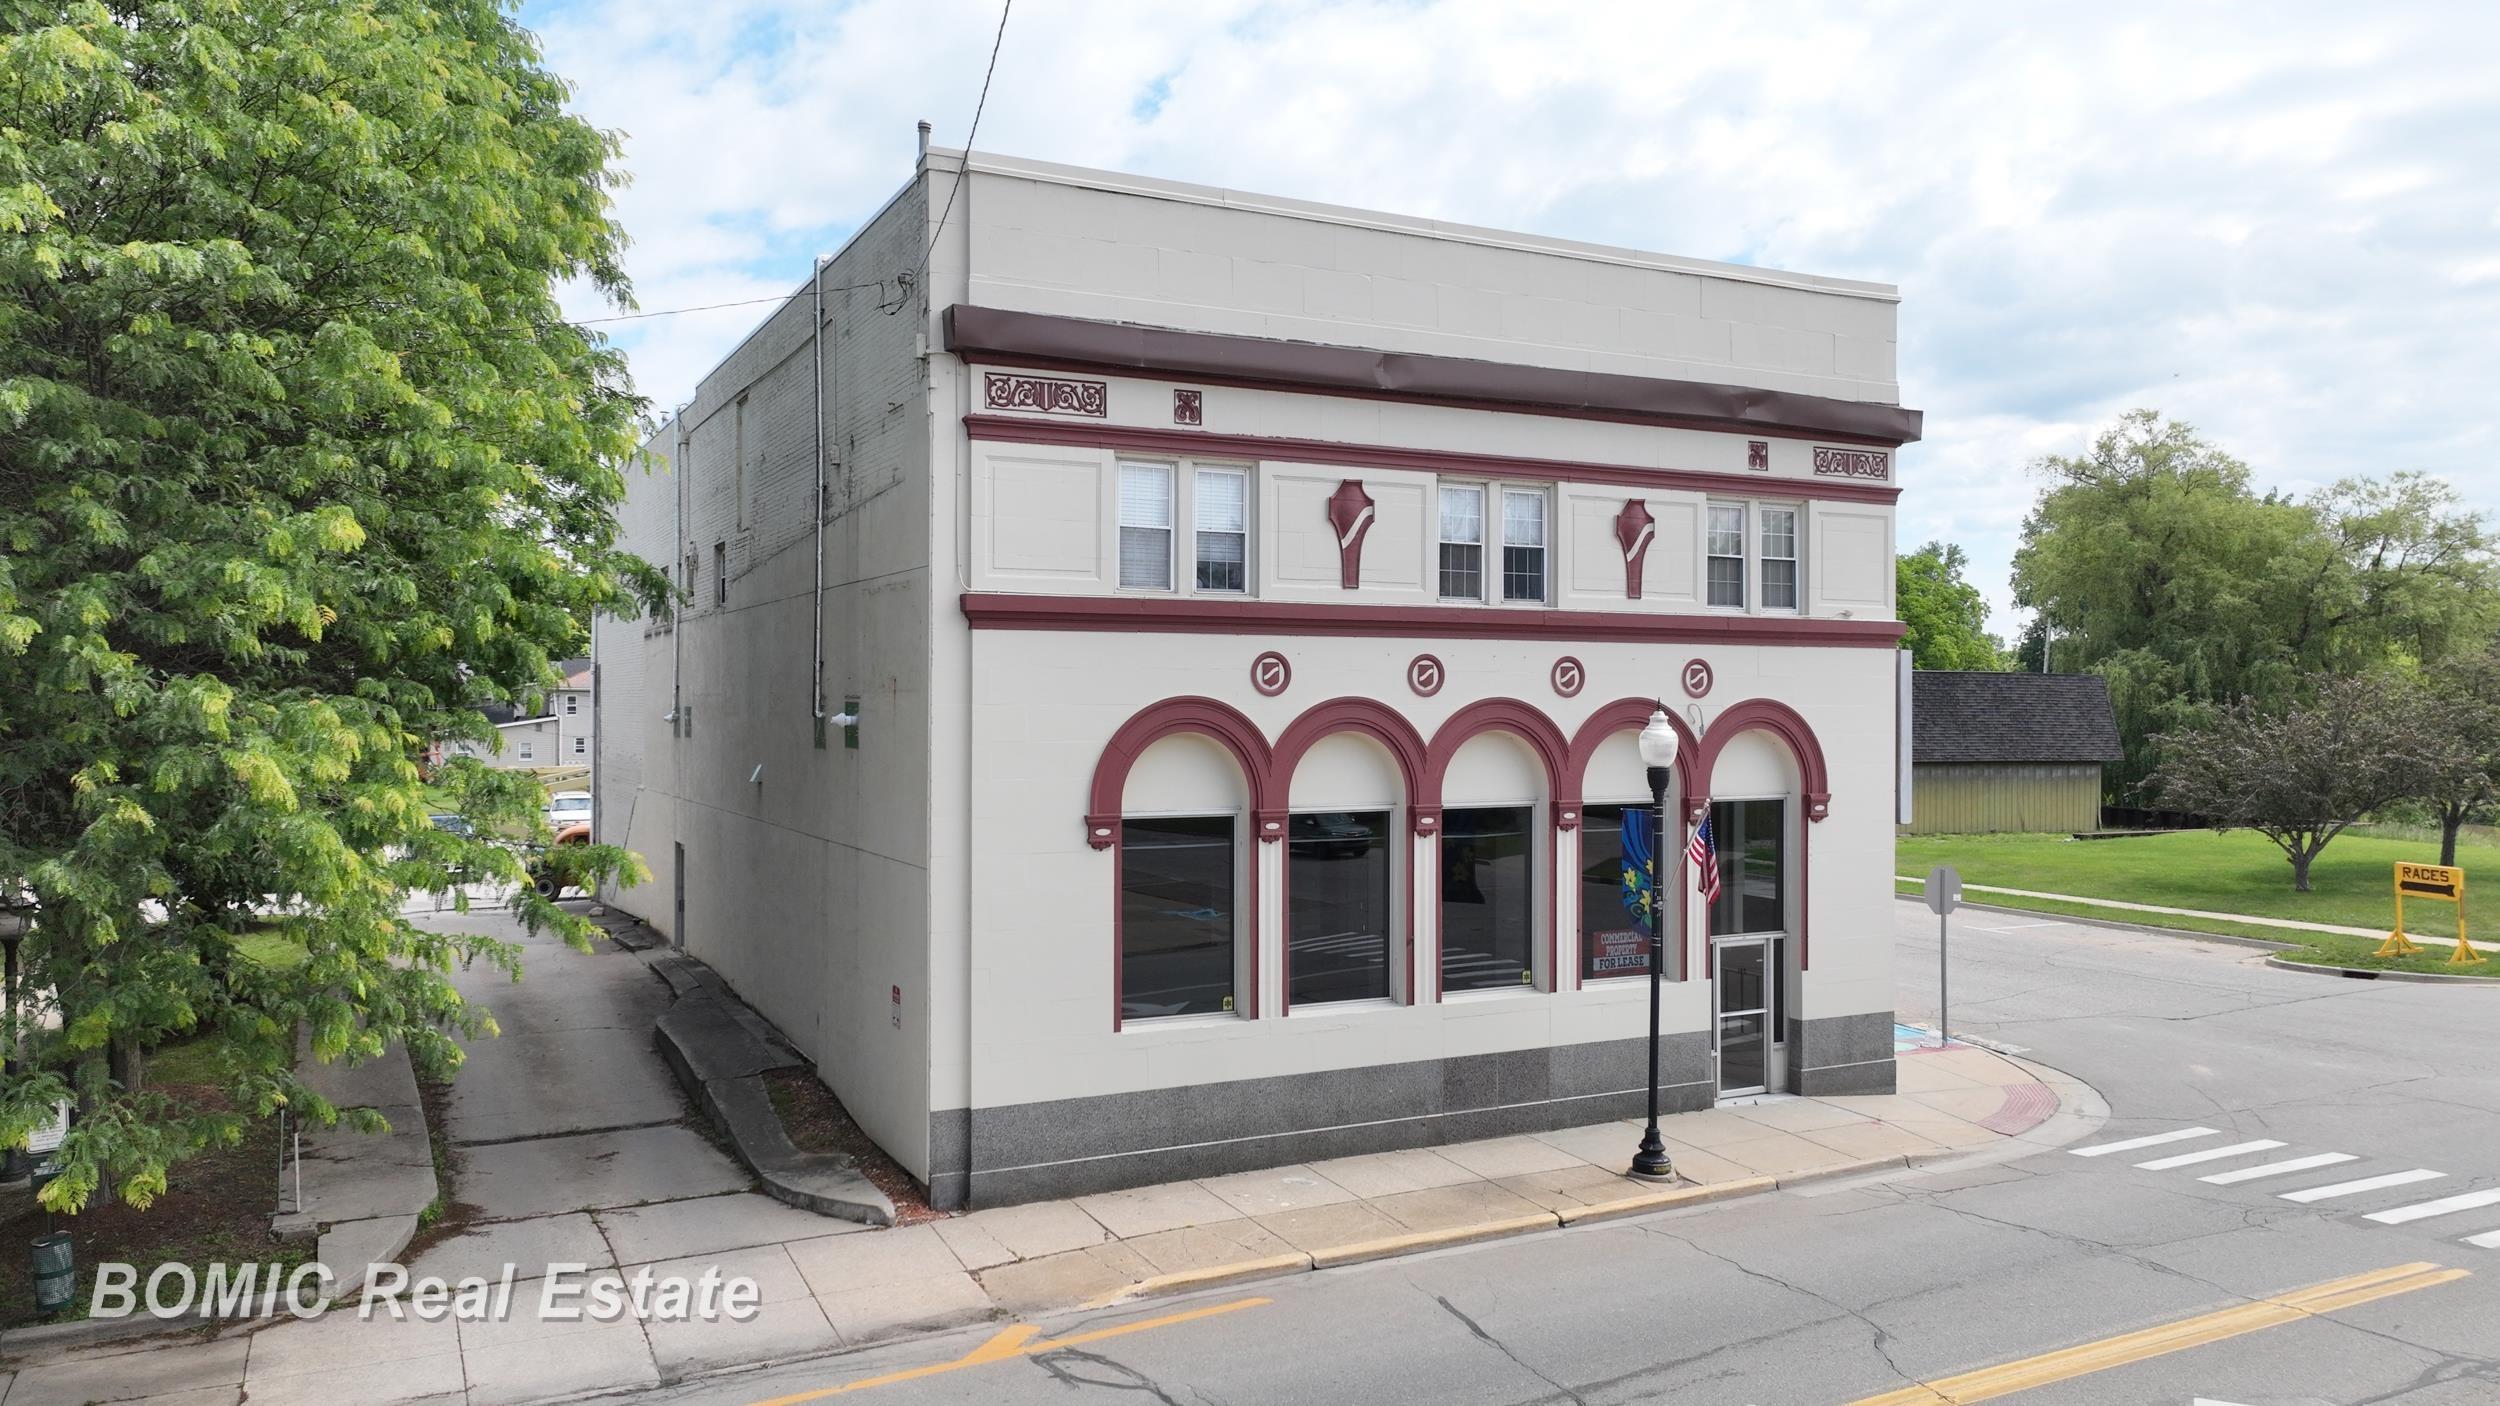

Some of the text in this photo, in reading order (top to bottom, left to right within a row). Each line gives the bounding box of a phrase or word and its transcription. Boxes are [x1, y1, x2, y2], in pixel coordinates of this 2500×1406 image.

[2402, 867, 2449, 882] RACES
[1601, 931, 1642, 944] COMMERCIAL
[1606, 944, 1637, 956] PROPERTY
[1600, 956, 1644, 969] FOR LEASE
